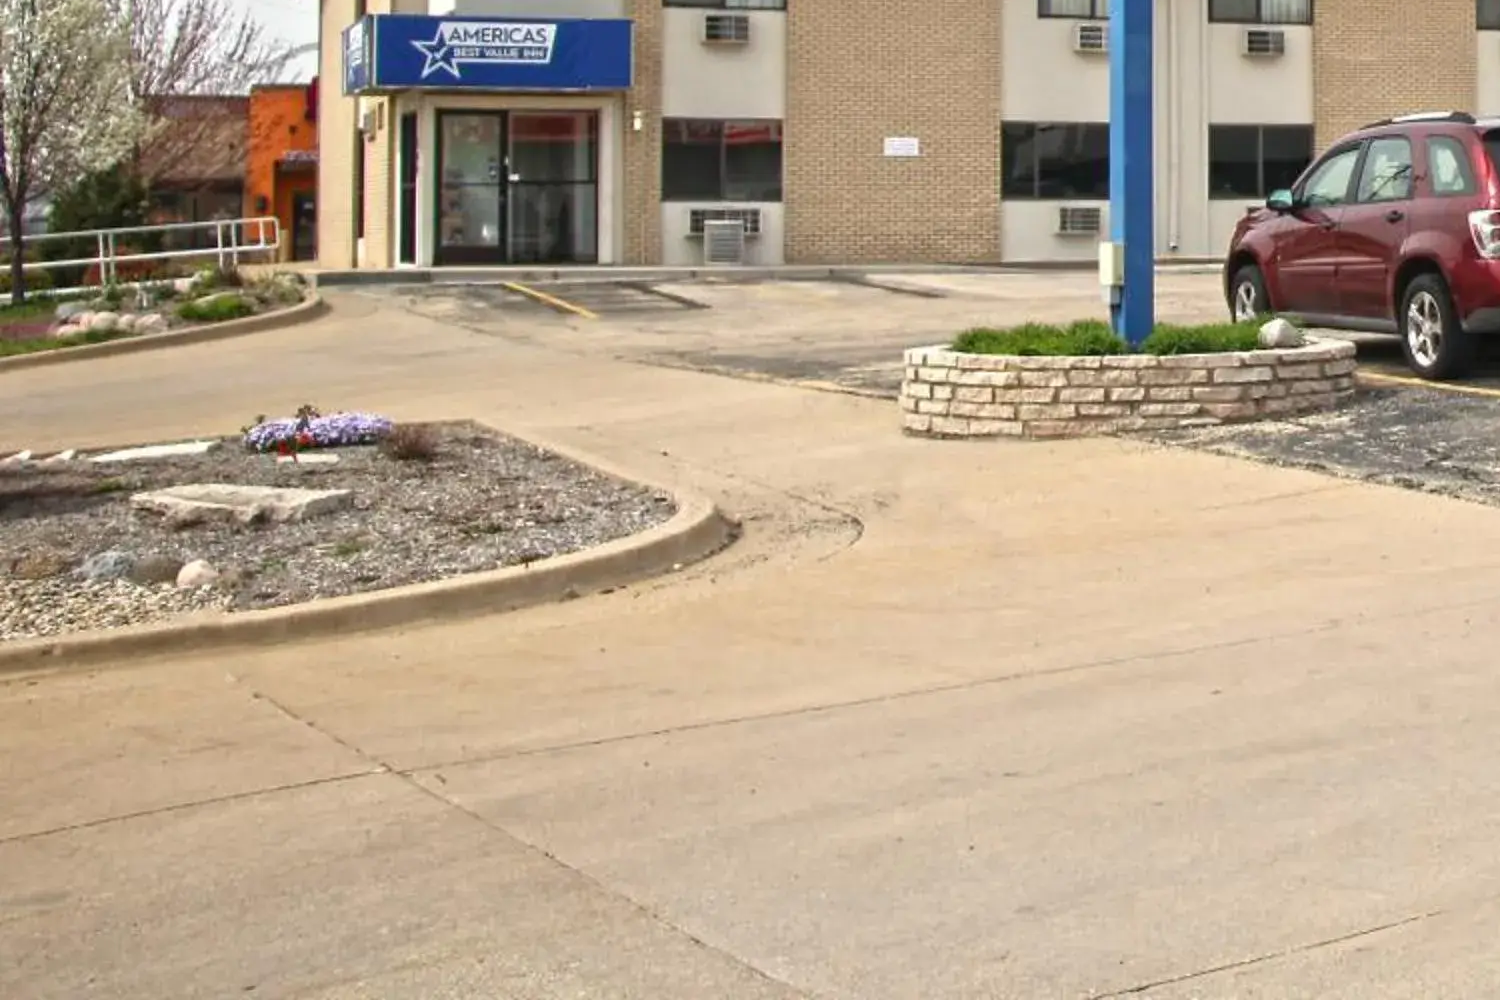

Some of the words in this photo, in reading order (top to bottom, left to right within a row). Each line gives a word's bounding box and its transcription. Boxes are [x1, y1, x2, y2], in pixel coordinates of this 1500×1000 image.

[448, 27, 547, 43] AMERICAS
[453, 47, 480, 57] BEST
[483, 47, 519, 57] VALUE
